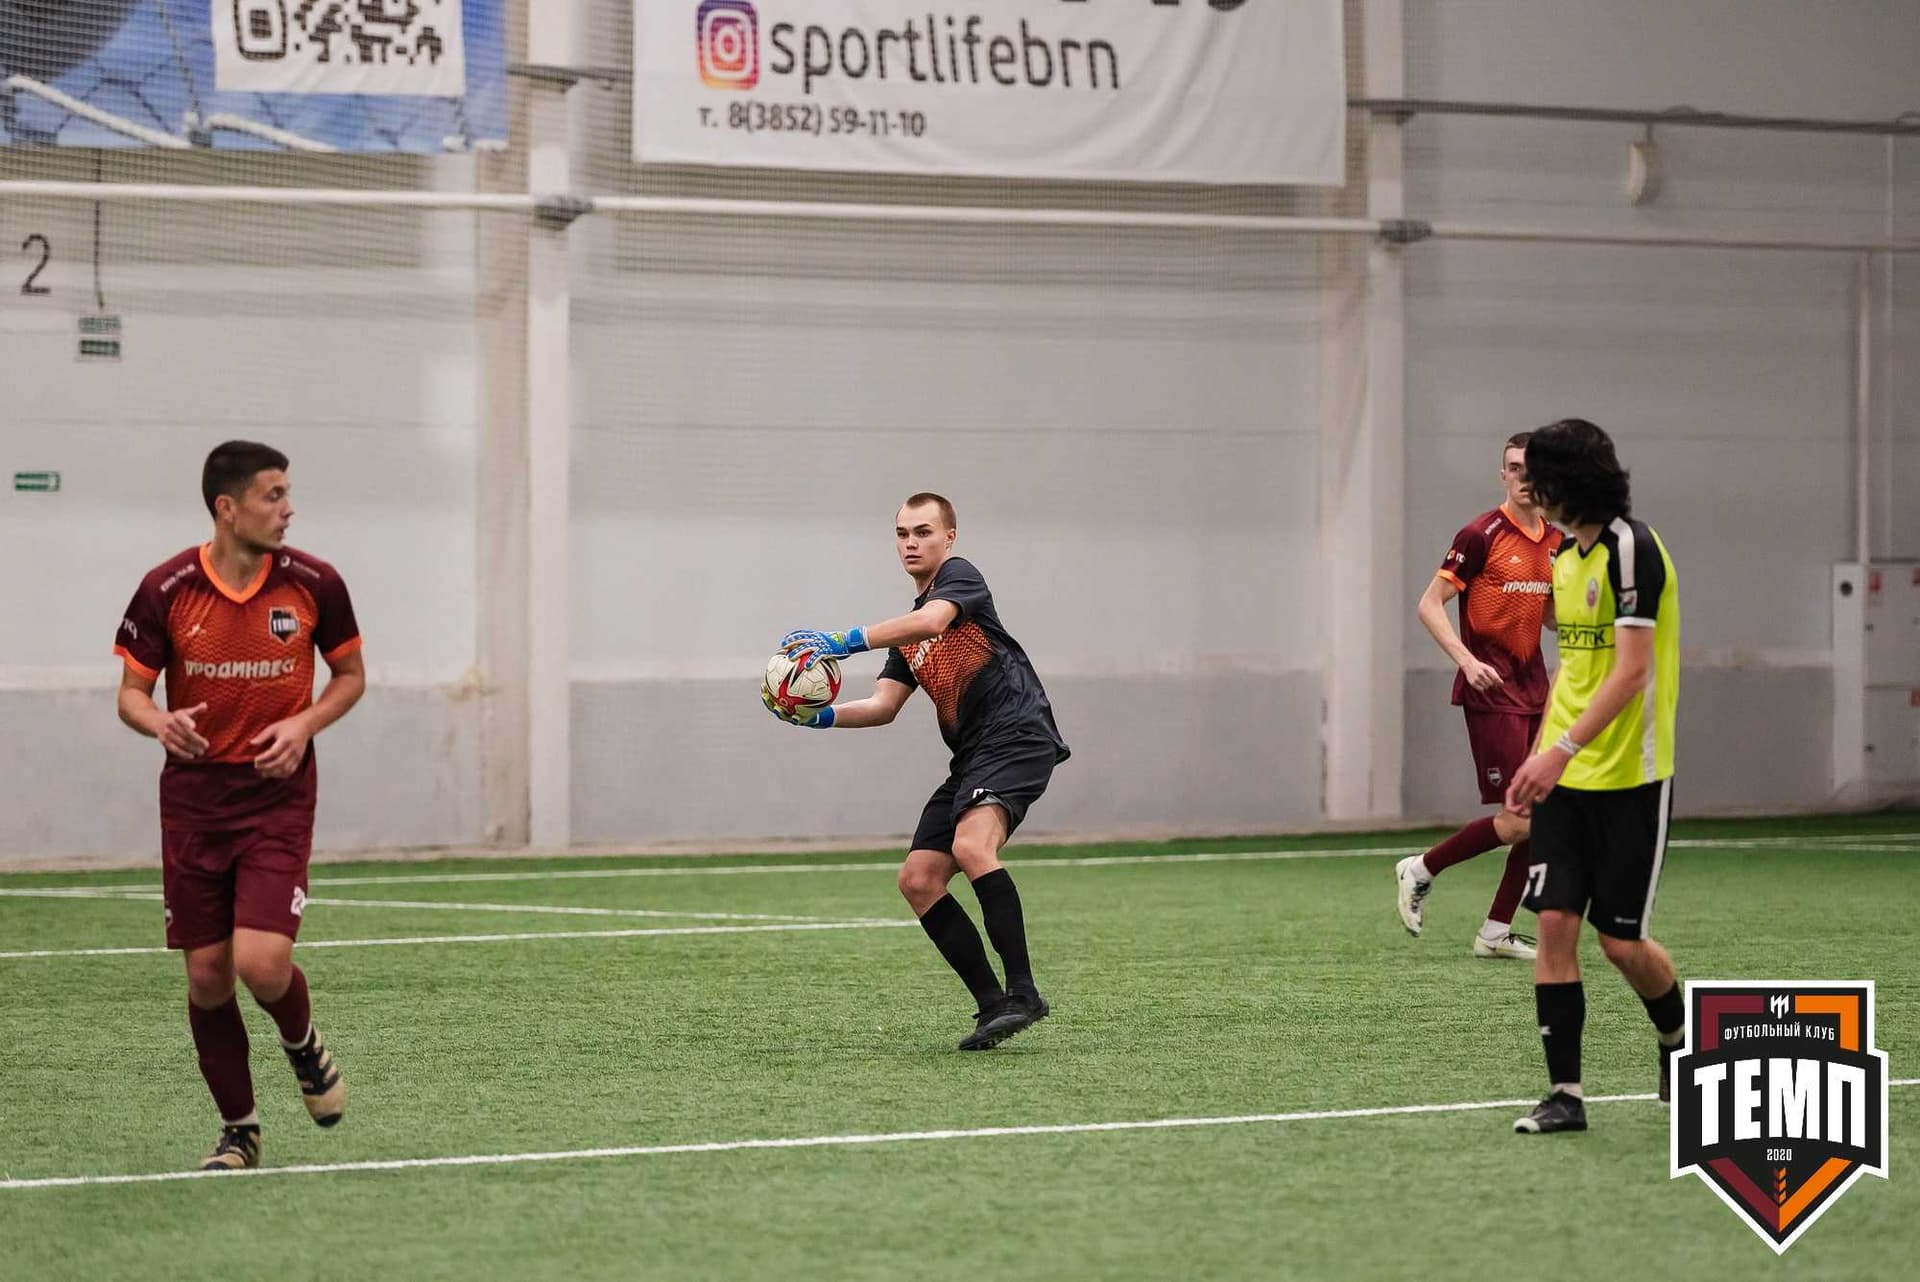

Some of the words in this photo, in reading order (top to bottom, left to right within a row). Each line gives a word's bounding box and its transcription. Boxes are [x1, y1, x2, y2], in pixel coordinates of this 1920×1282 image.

[770, 14, 1121, 94] sportlifebrn
[729, 102, 822, 136] 8(3852)
[829, 106, 927, 137] 59-11-10
[21, 233, 51, 294] 2
